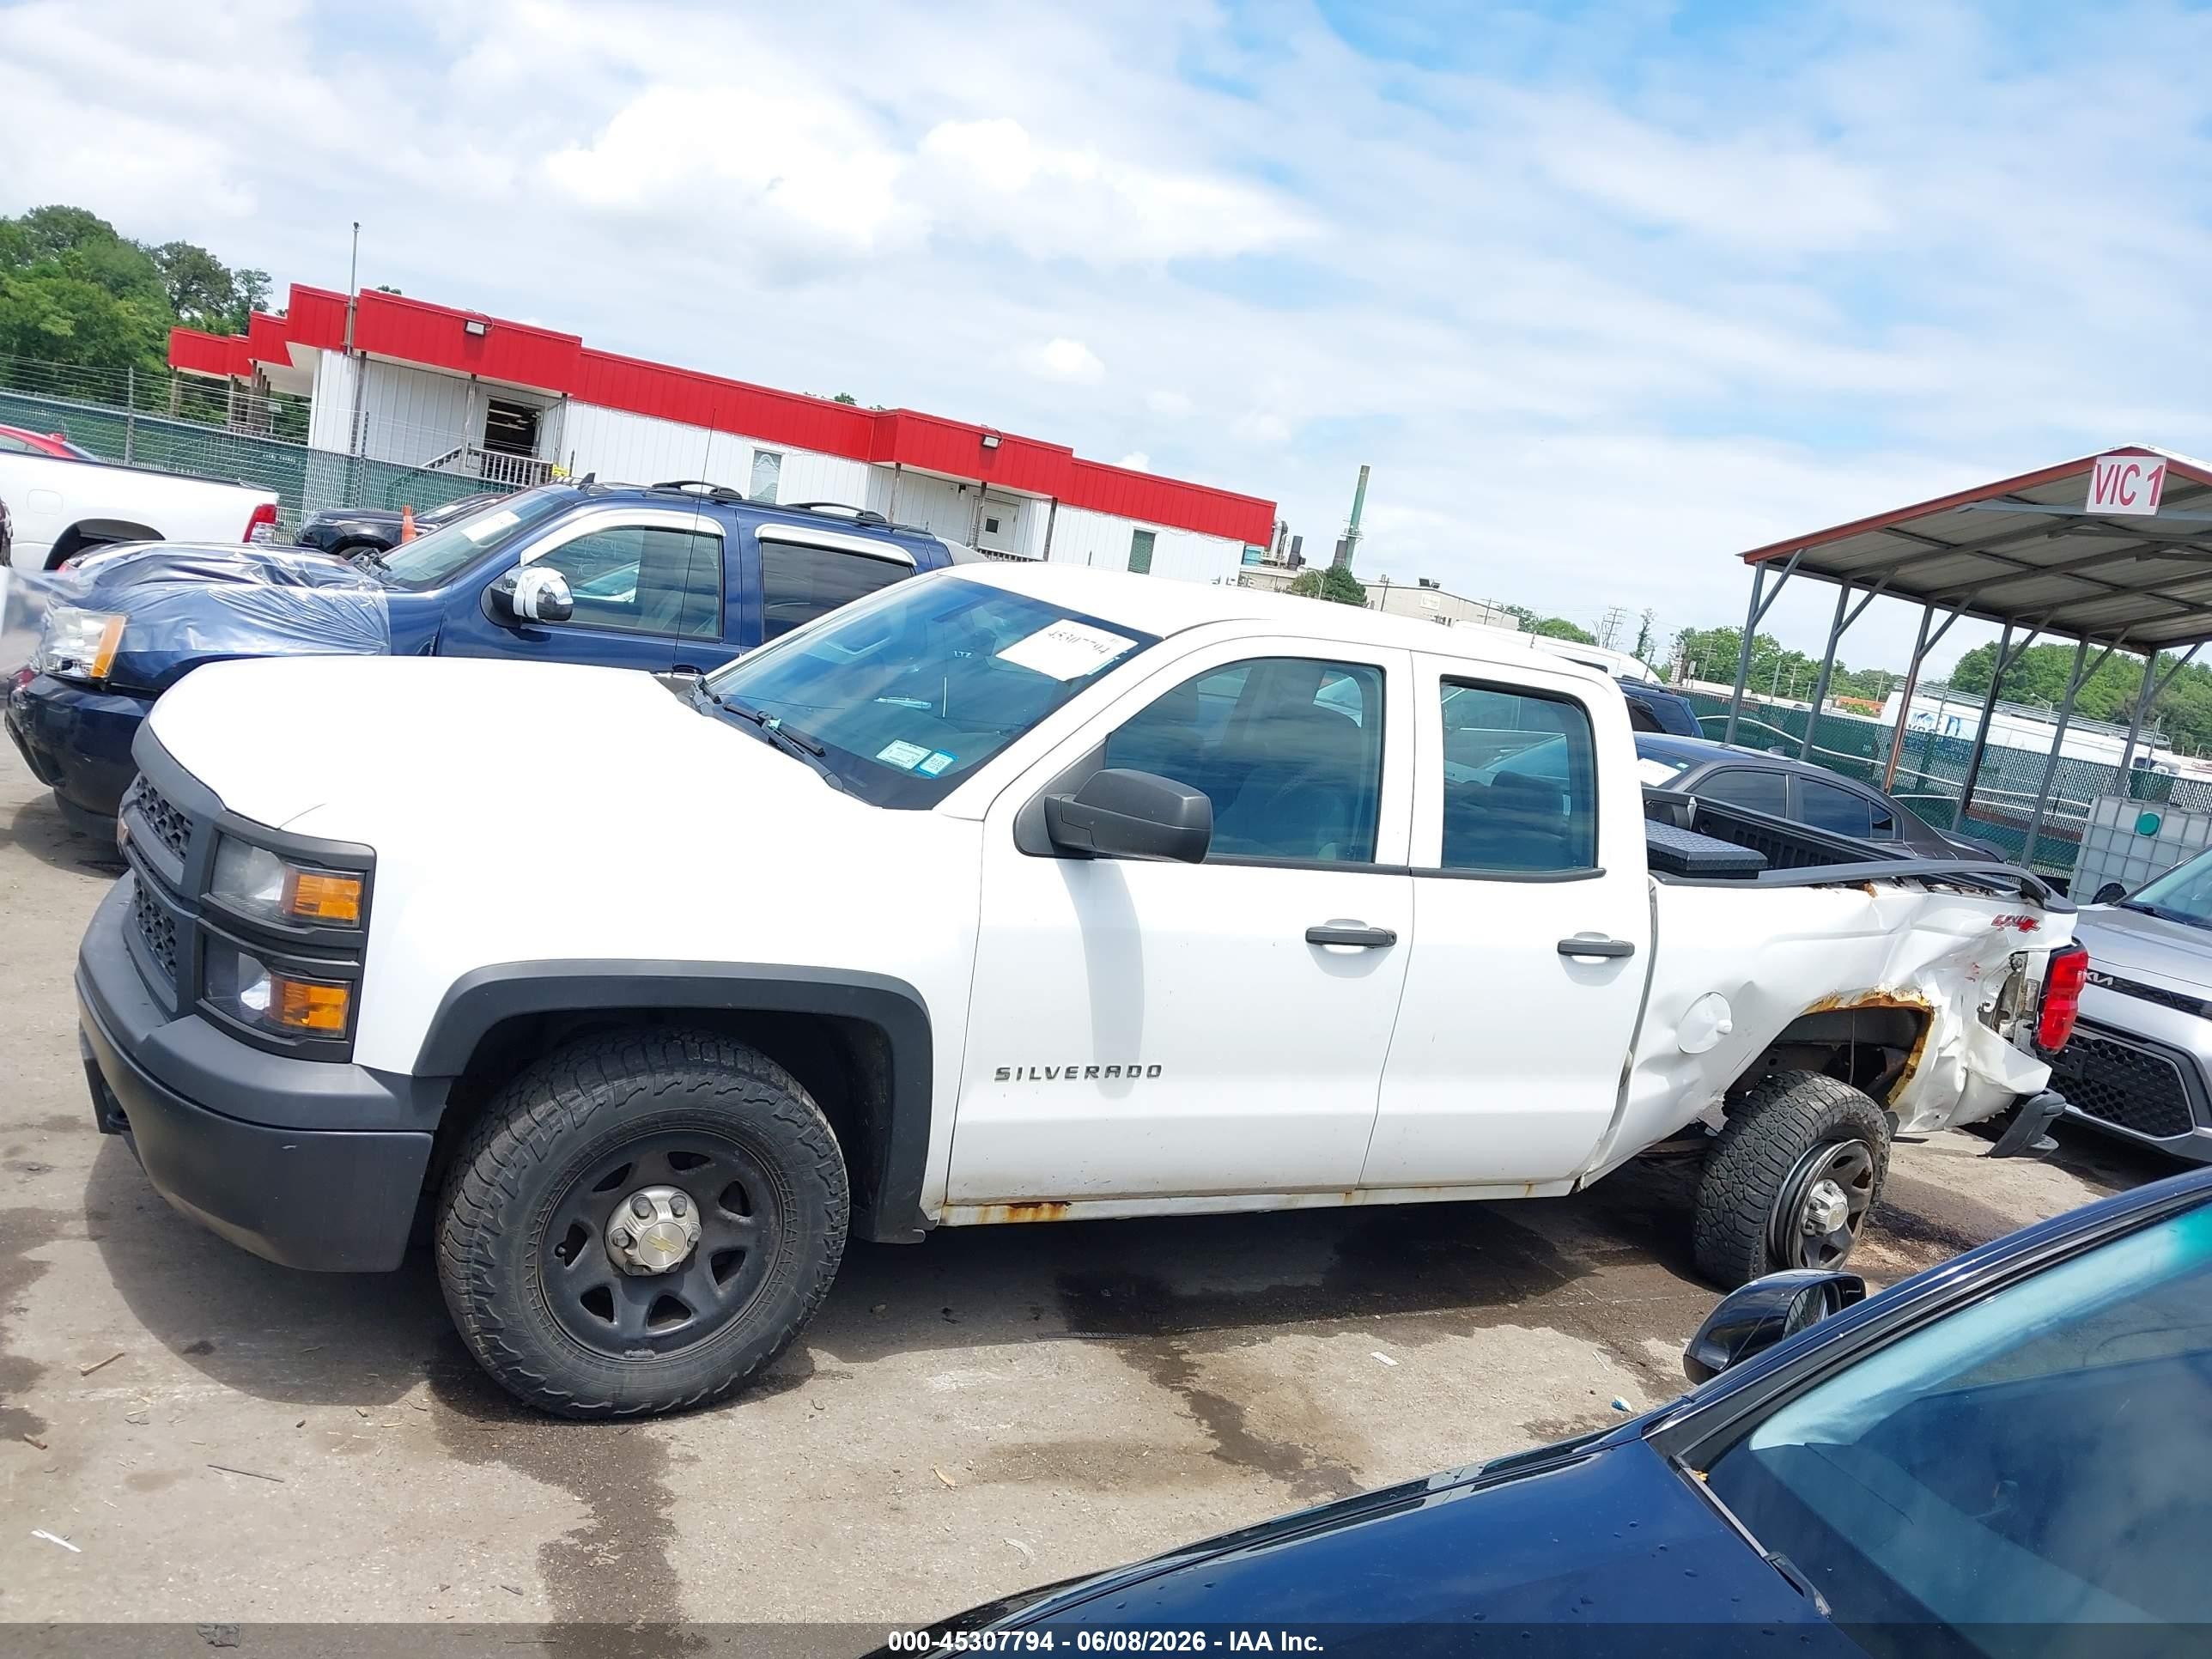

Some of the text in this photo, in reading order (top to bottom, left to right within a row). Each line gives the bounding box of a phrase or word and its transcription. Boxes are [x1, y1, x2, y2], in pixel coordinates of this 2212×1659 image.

[2095, 464, 2164, 506] VIC 1
[954, 650, 972, 659] LTZ
[994, 1064, 1162, 1081] SILVERADO
